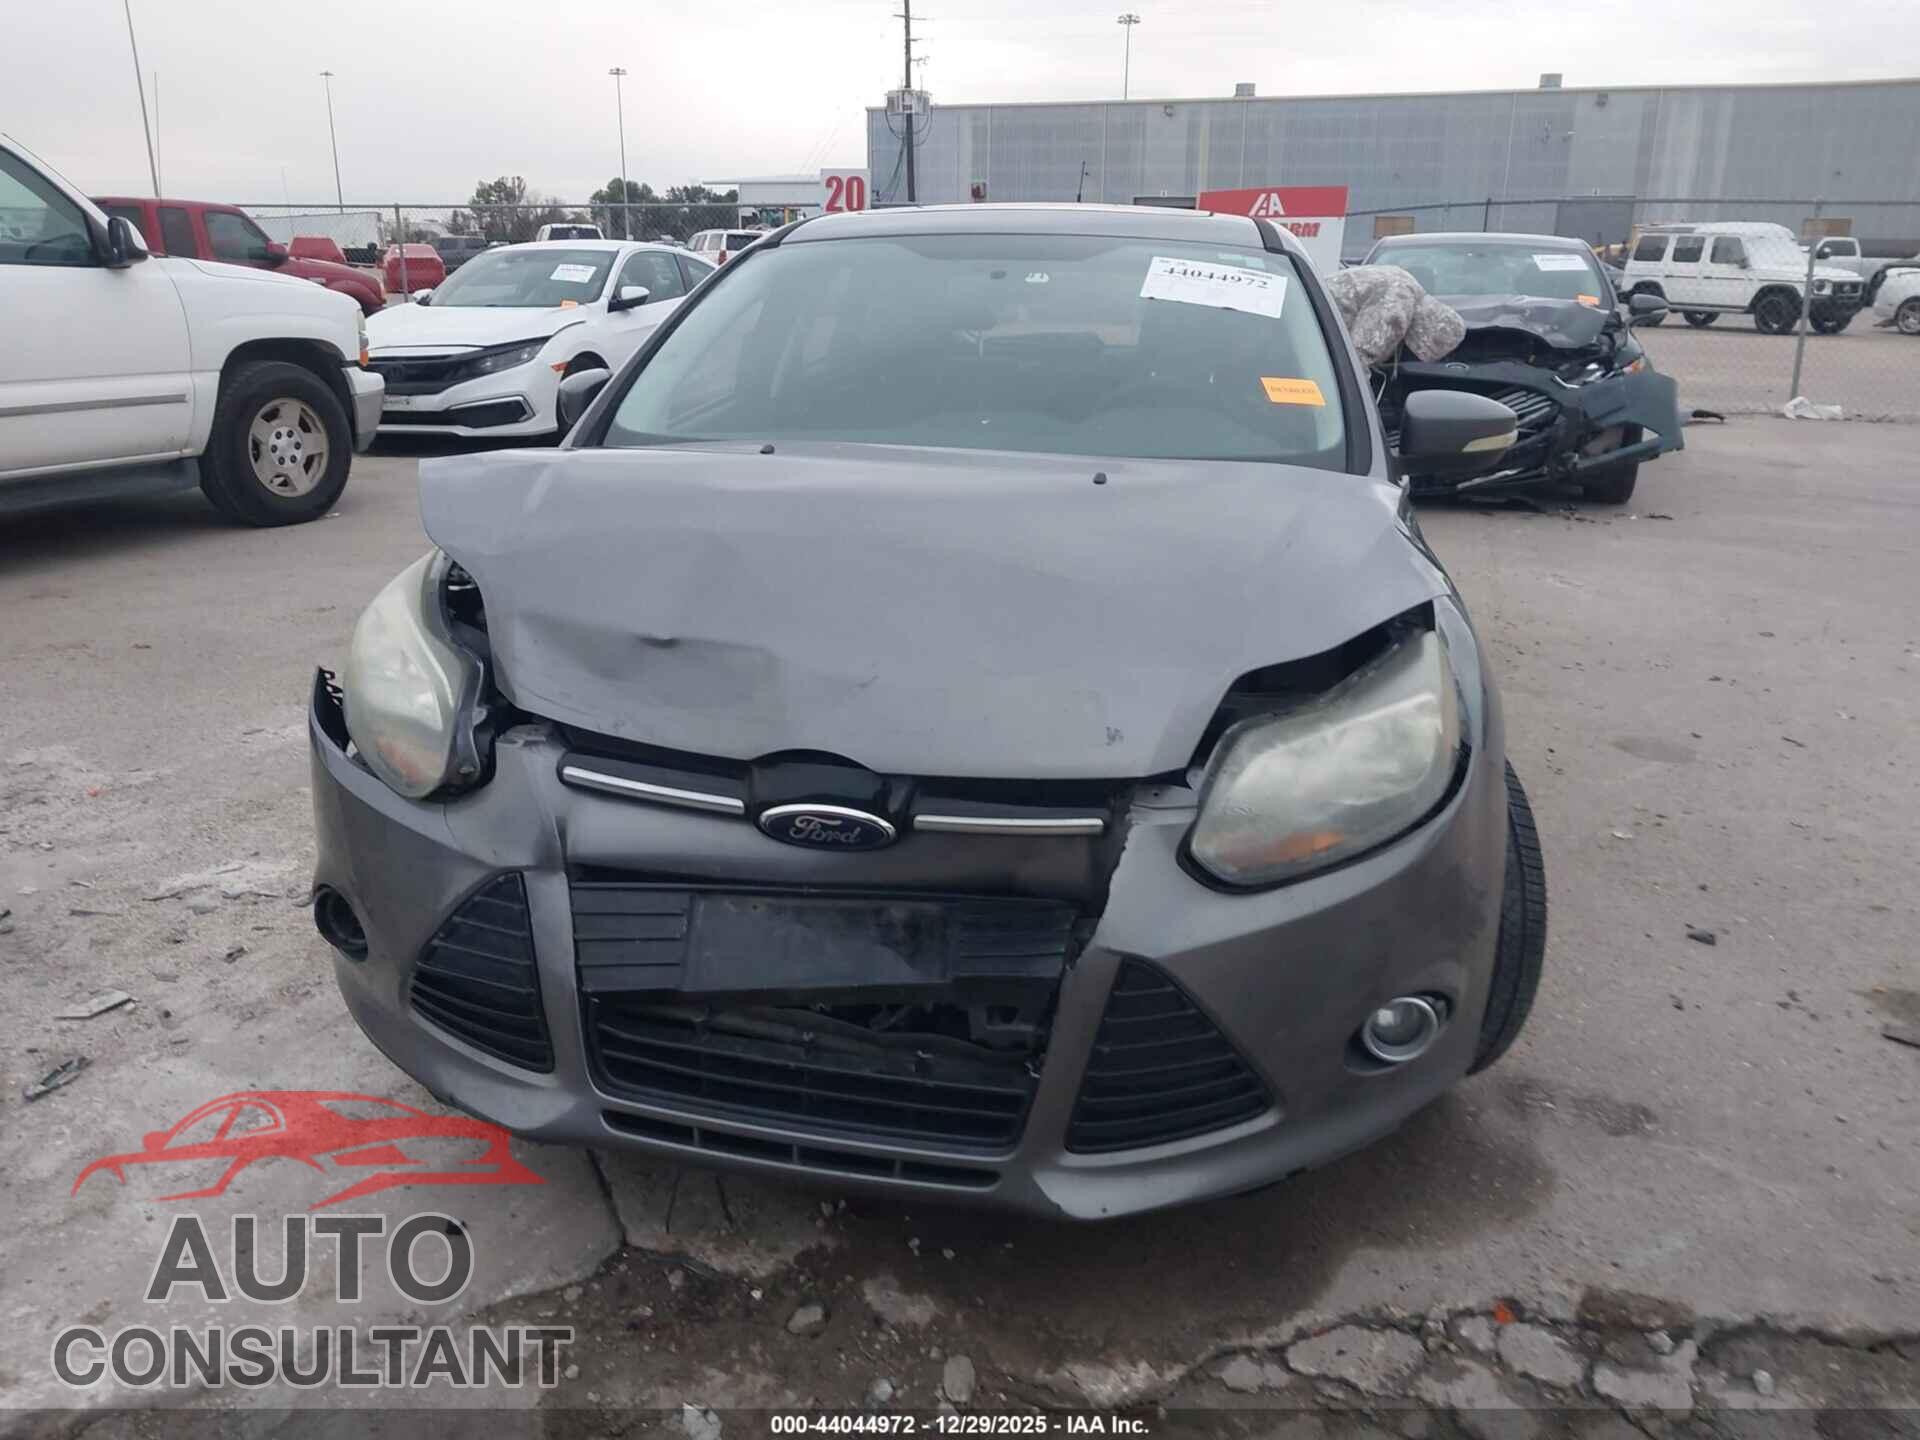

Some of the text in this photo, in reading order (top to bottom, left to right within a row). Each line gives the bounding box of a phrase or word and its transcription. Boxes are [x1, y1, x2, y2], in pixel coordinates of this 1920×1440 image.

[825, 175, 865, 212] 20
[1162, 267, 1269, 289] 44044972
[789, 815, 862, 843] Ford
